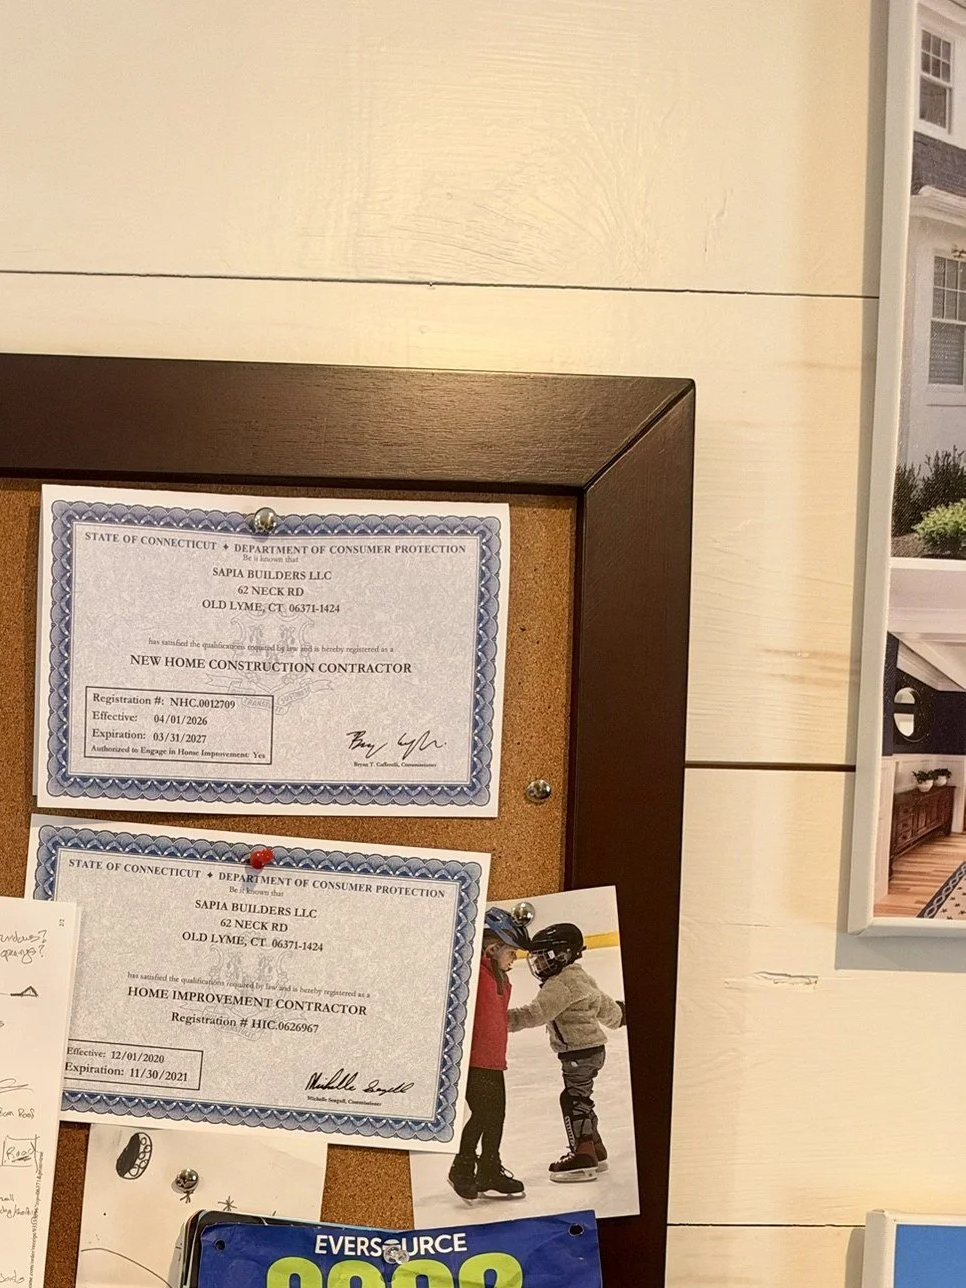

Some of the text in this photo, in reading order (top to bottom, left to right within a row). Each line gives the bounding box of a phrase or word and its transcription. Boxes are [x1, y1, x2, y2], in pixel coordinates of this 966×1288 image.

[85, 532, 466, 555] STATE OF CONNECTICUT DEPARTMENT OF CONSUMER PROTECTION
[213, 567, 332, 581] SAPIA BUILDERS LLC
[238, 586, 304, 597] 62 NECK RD
[202, 600, 340, 613] OLD LYME, CT 06371-1424
[130, 655, 412, 673] NEW HOME CONSTRUCTION CONTRACTOR
[93, 693, 236, 709] Registration #: NHC.0012709
[92, 711, 208, 725] Effective: 04/01/2026
[92, 729, 207, 744] Expiration: 03/31/2027
[128, 986, 367, 1016] HOME IMPROVEMENT CONTRACTOR
[171, 1011, 319, 1034] Registration # HIC.0626967
[111, 1050, 165, 1063] 12/01/2020
[64, 1062, 188, 1082] Expiration: 11/30/2021
